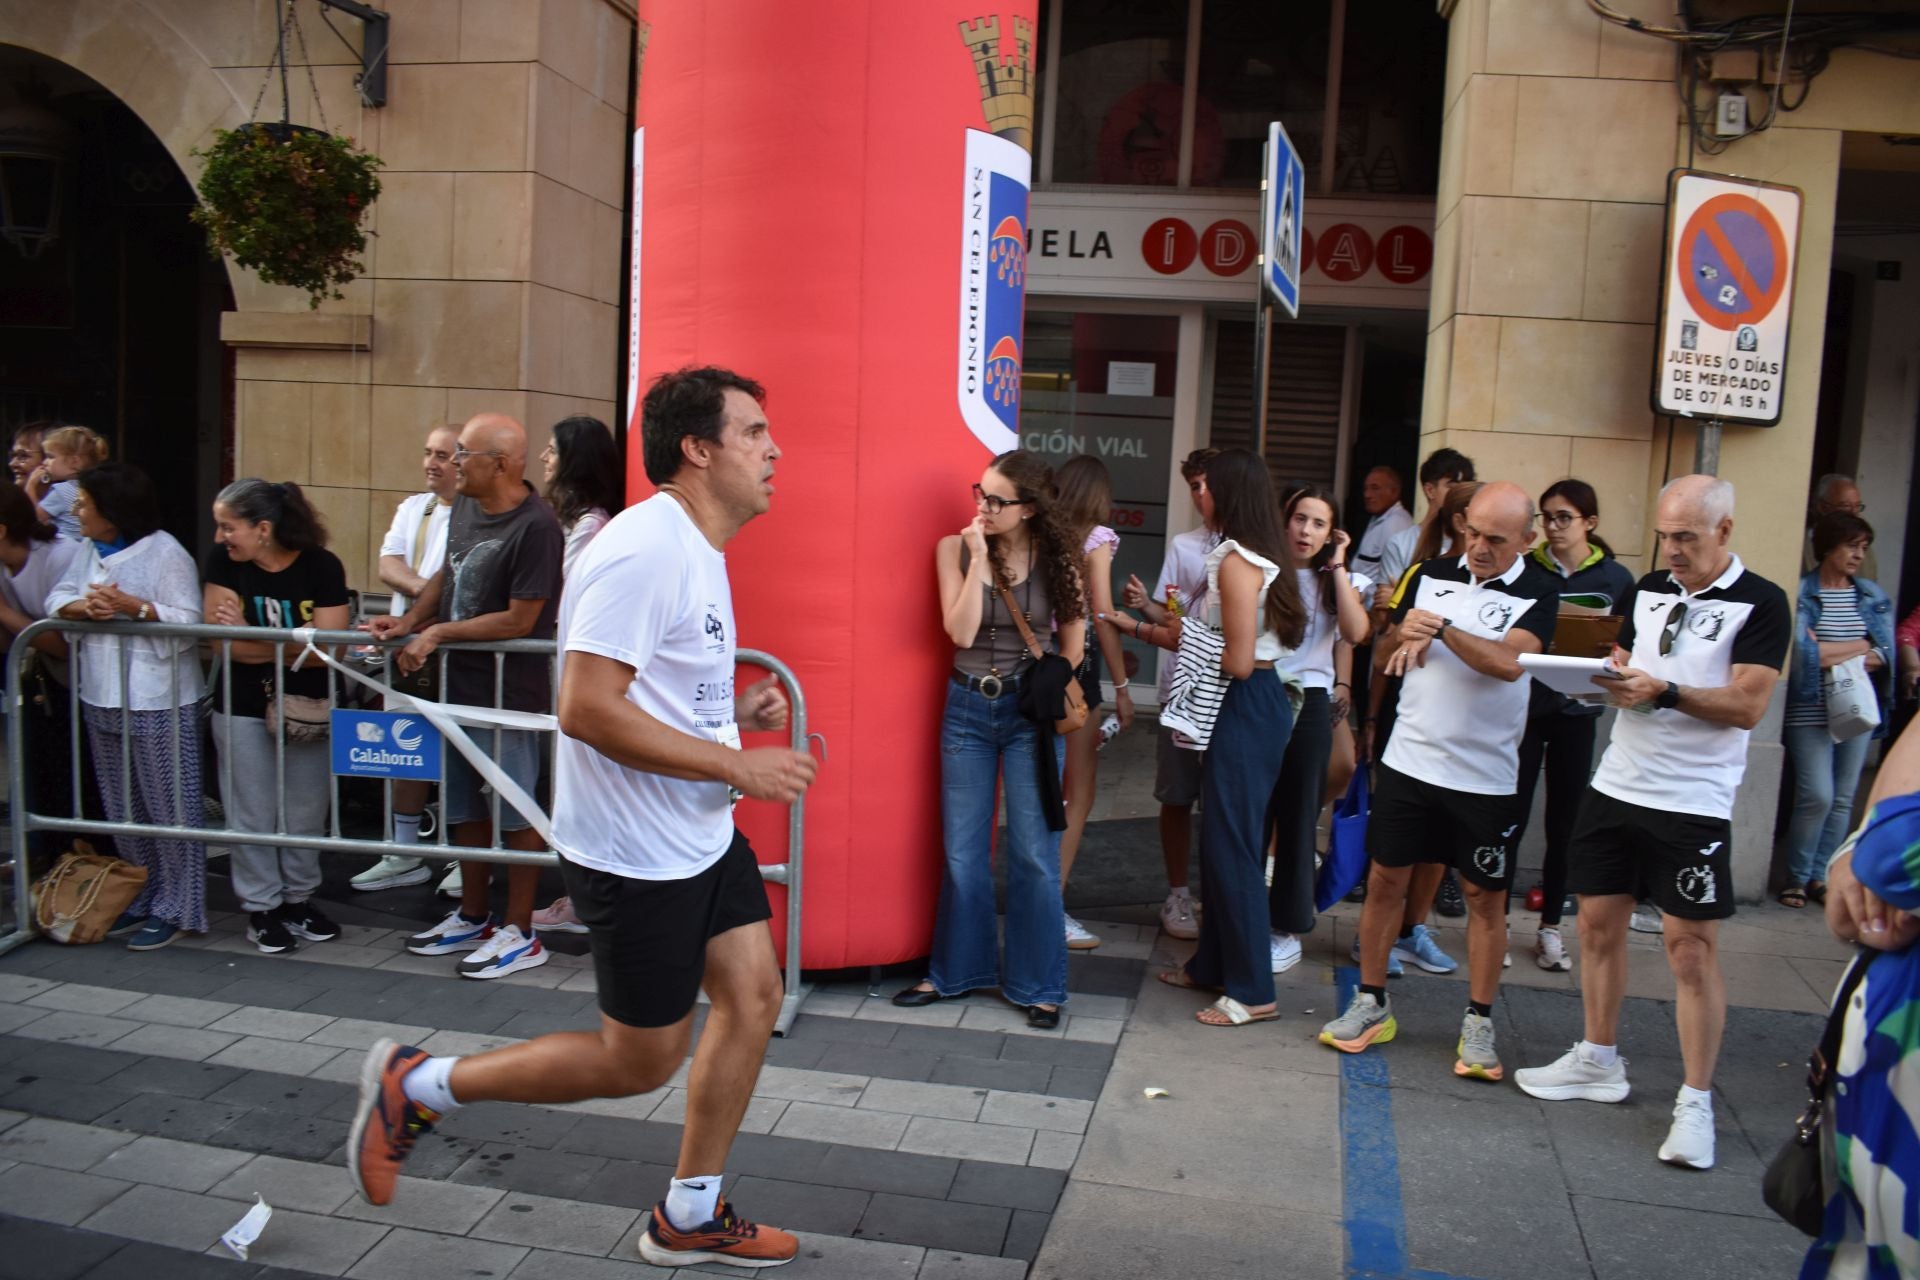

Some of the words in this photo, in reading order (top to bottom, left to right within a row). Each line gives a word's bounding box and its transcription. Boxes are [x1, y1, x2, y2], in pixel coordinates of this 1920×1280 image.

[972, 167, 983, 219] SAN
[967, 229, 981, 394] CELEDONIO
[1668, 351, 1722, 368] JUEVES
[1728, 358, 1738, 370] O
[1745, 356, 1779, 375] DÍAS
[1674, 369, 1692, 382] DE
[1698, 372, 1771, 391] MERCADO
[1674, 388, 1693, 401] DE
[1699, 391, 1717, 404] 07
[1723, 394, 1732, 405] A
[1740, 396, 1753, 408] 15
[1759, 397, 1767, 410] h
[1096, 436, 1148, 458] VIAL
[350, 747, 424, 767] Calahorra
